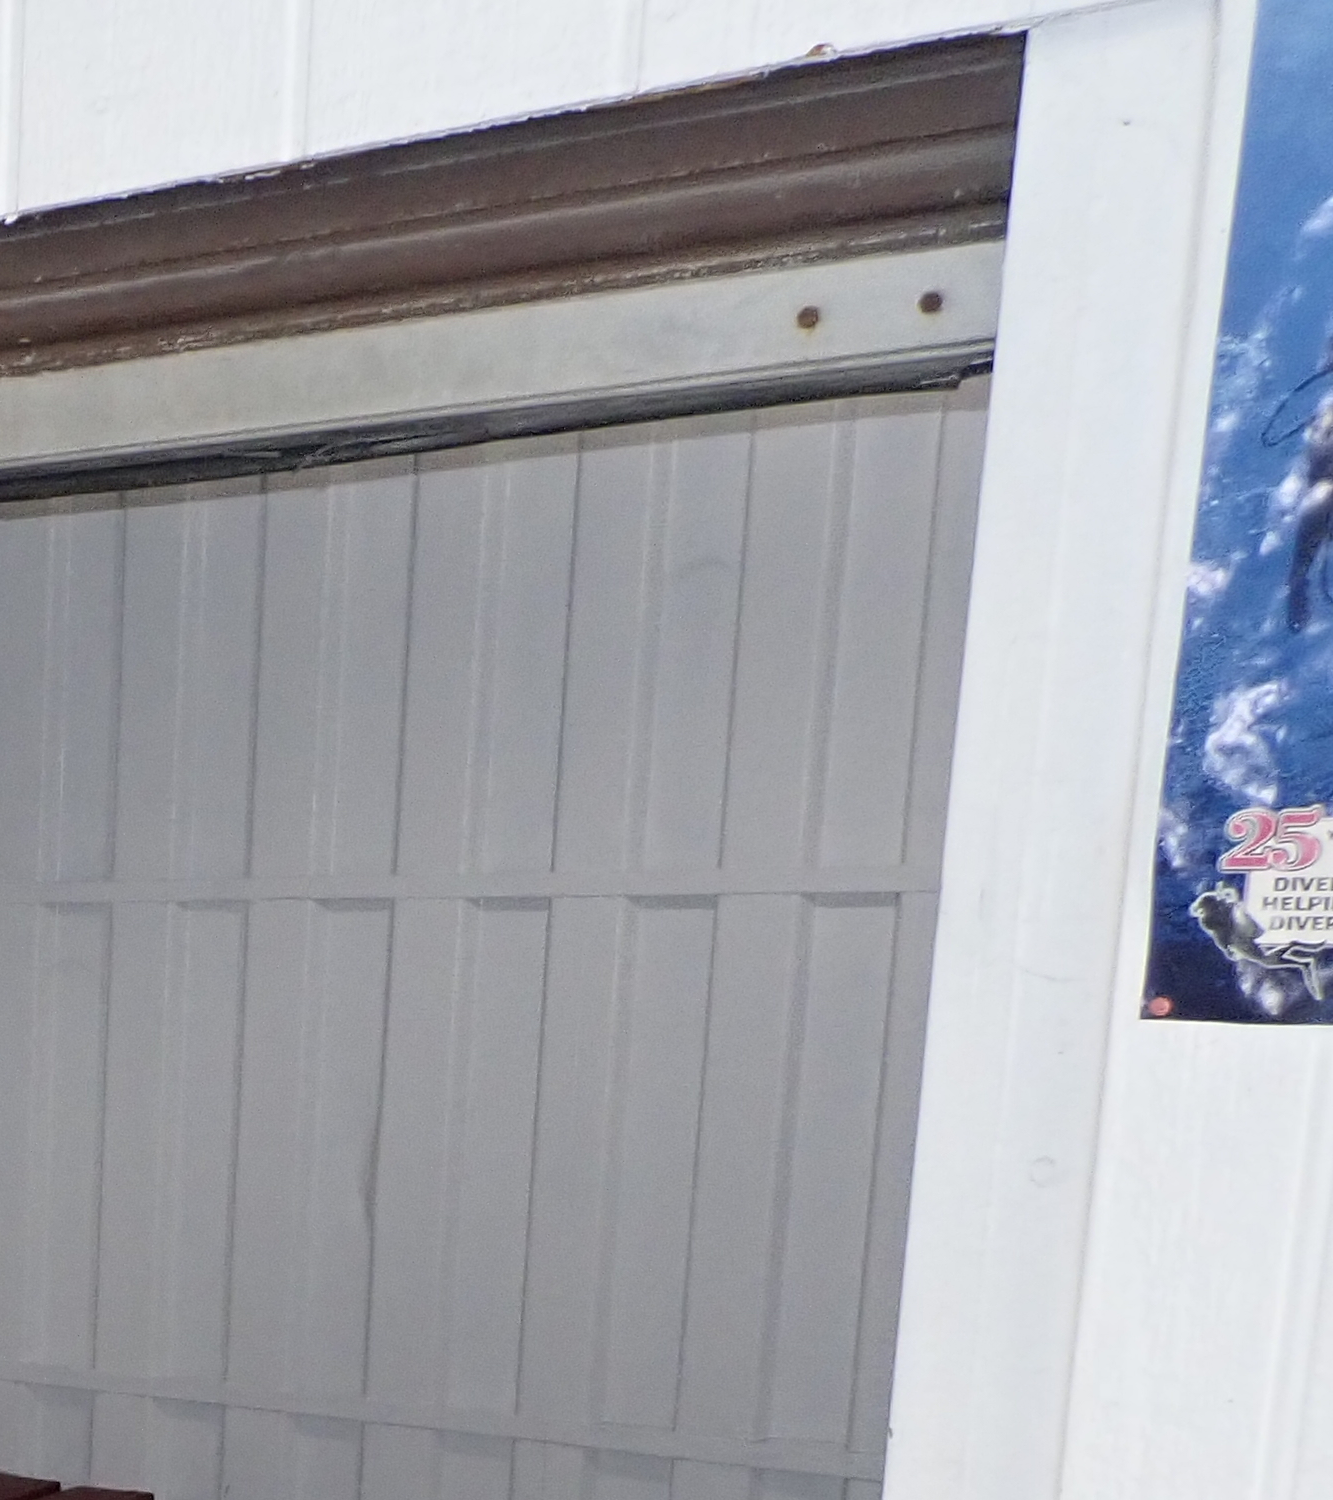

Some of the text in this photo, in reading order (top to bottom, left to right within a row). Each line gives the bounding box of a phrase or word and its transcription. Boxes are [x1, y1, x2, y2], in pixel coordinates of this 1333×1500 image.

[1217, 803, 1323, 874] 25
[1274, 876, 1333, 892] DIVE
[1261, 896, 1333, 911] HELPI
